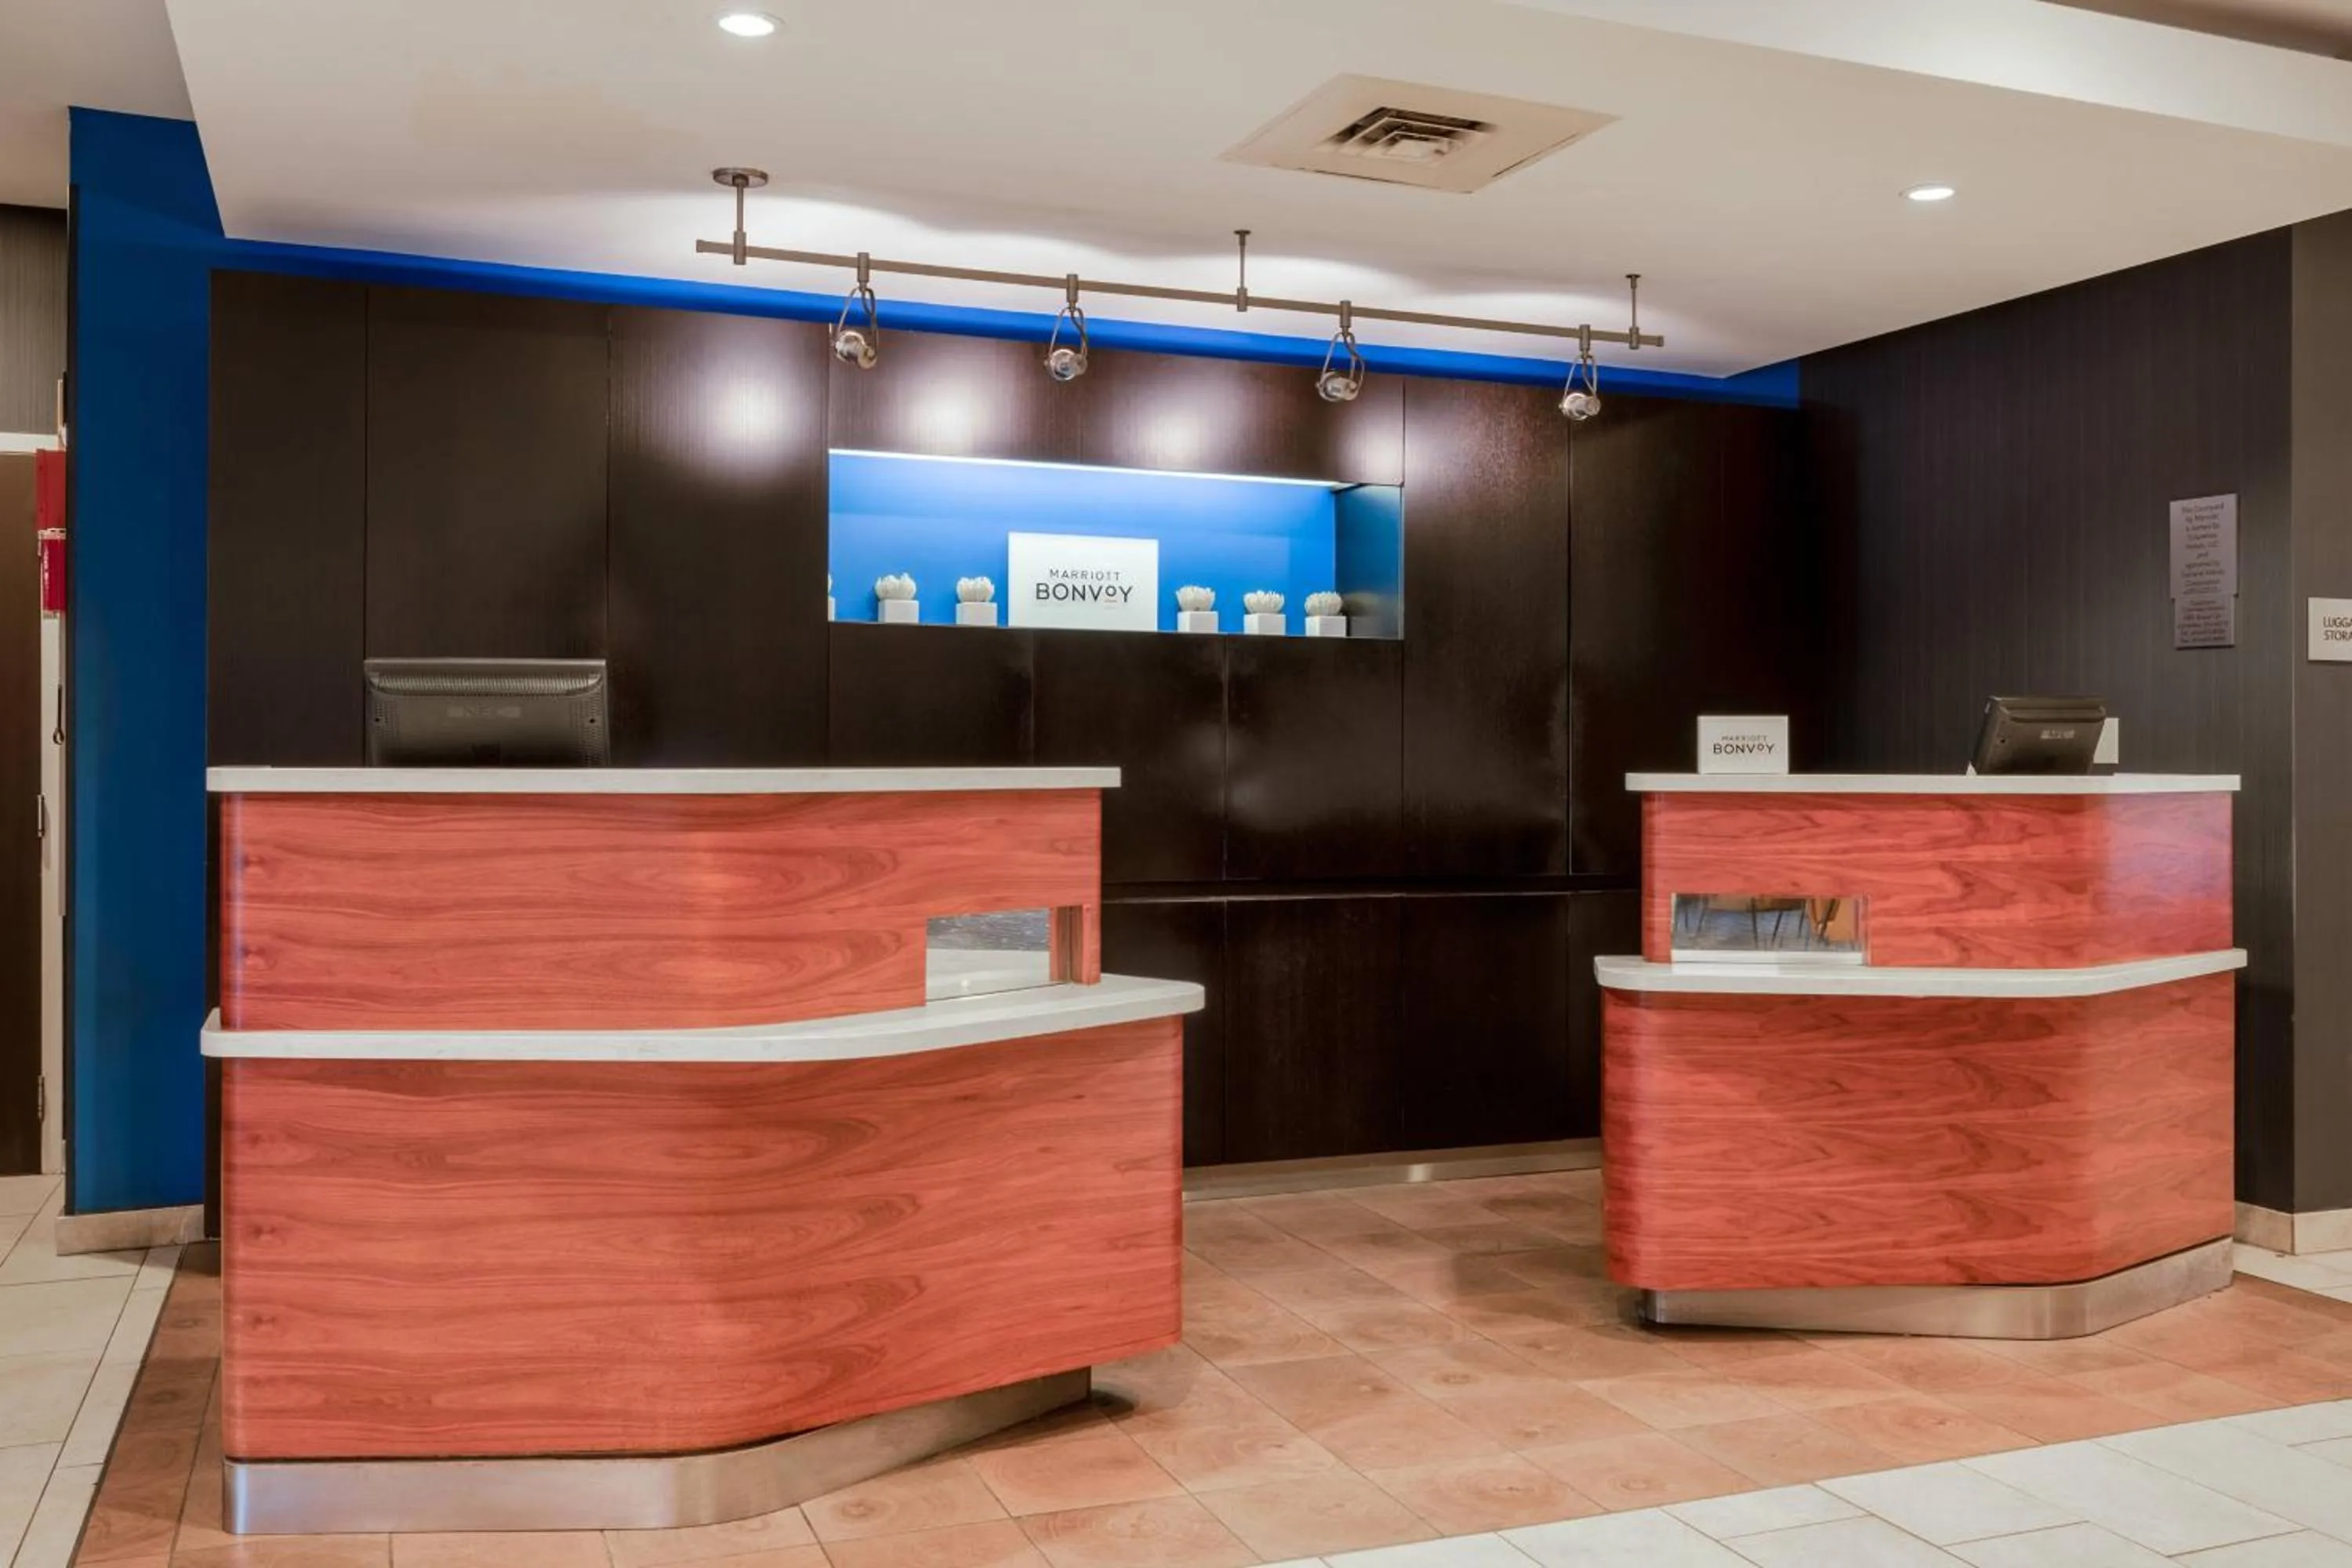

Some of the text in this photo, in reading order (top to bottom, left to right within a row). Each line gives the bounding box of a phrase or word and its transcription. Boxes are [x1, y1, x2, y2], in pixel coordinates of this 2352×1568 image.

[1049, 568, 1121, 581] MARRIOTT
[1035, 583, 1133, 604] BONVOY
[1712, 742, 1775, 754] BONVOY
